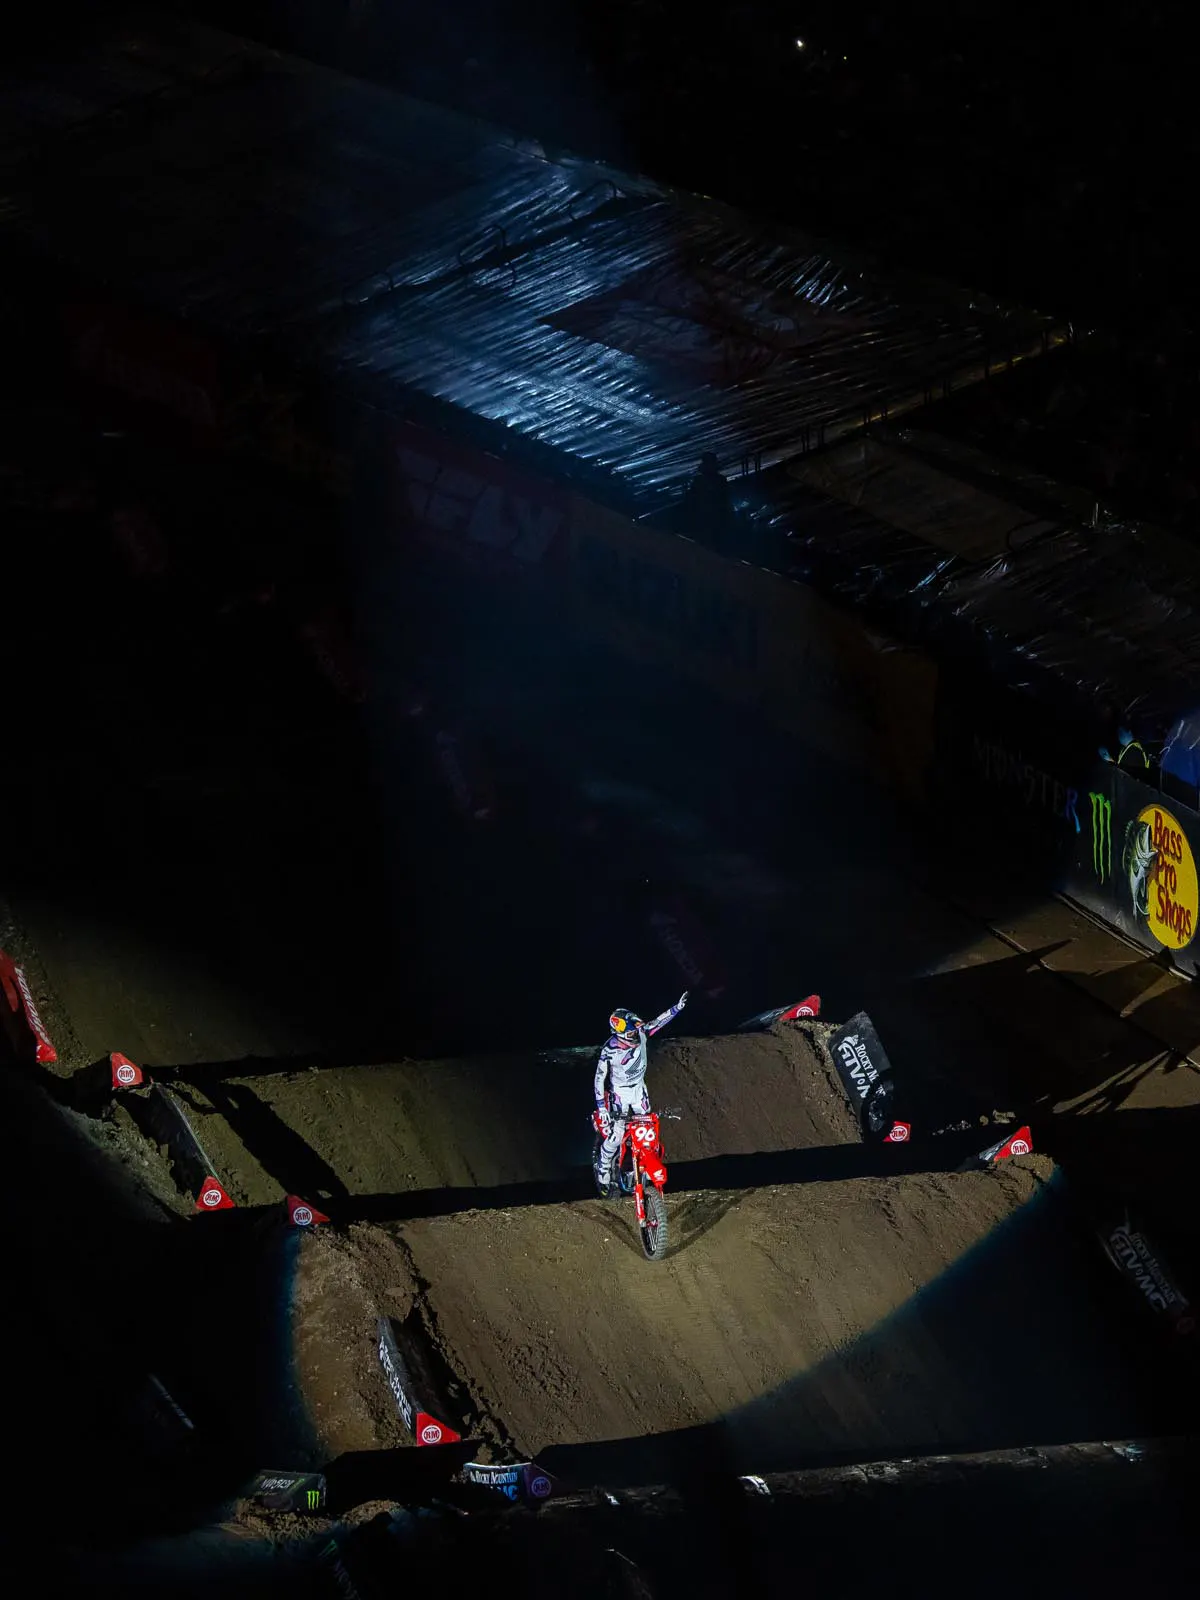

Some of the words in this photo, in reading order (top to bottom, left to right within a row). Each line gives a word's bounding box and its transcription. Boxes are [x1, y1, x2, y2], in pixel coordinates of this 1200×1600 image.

[1153, 809, 1183, 865] Bass
[1154, 850, 1177, 895] Pro
[1154, 885, 1193, 945] Shops
[635, 1127, 656, 1142] 96
